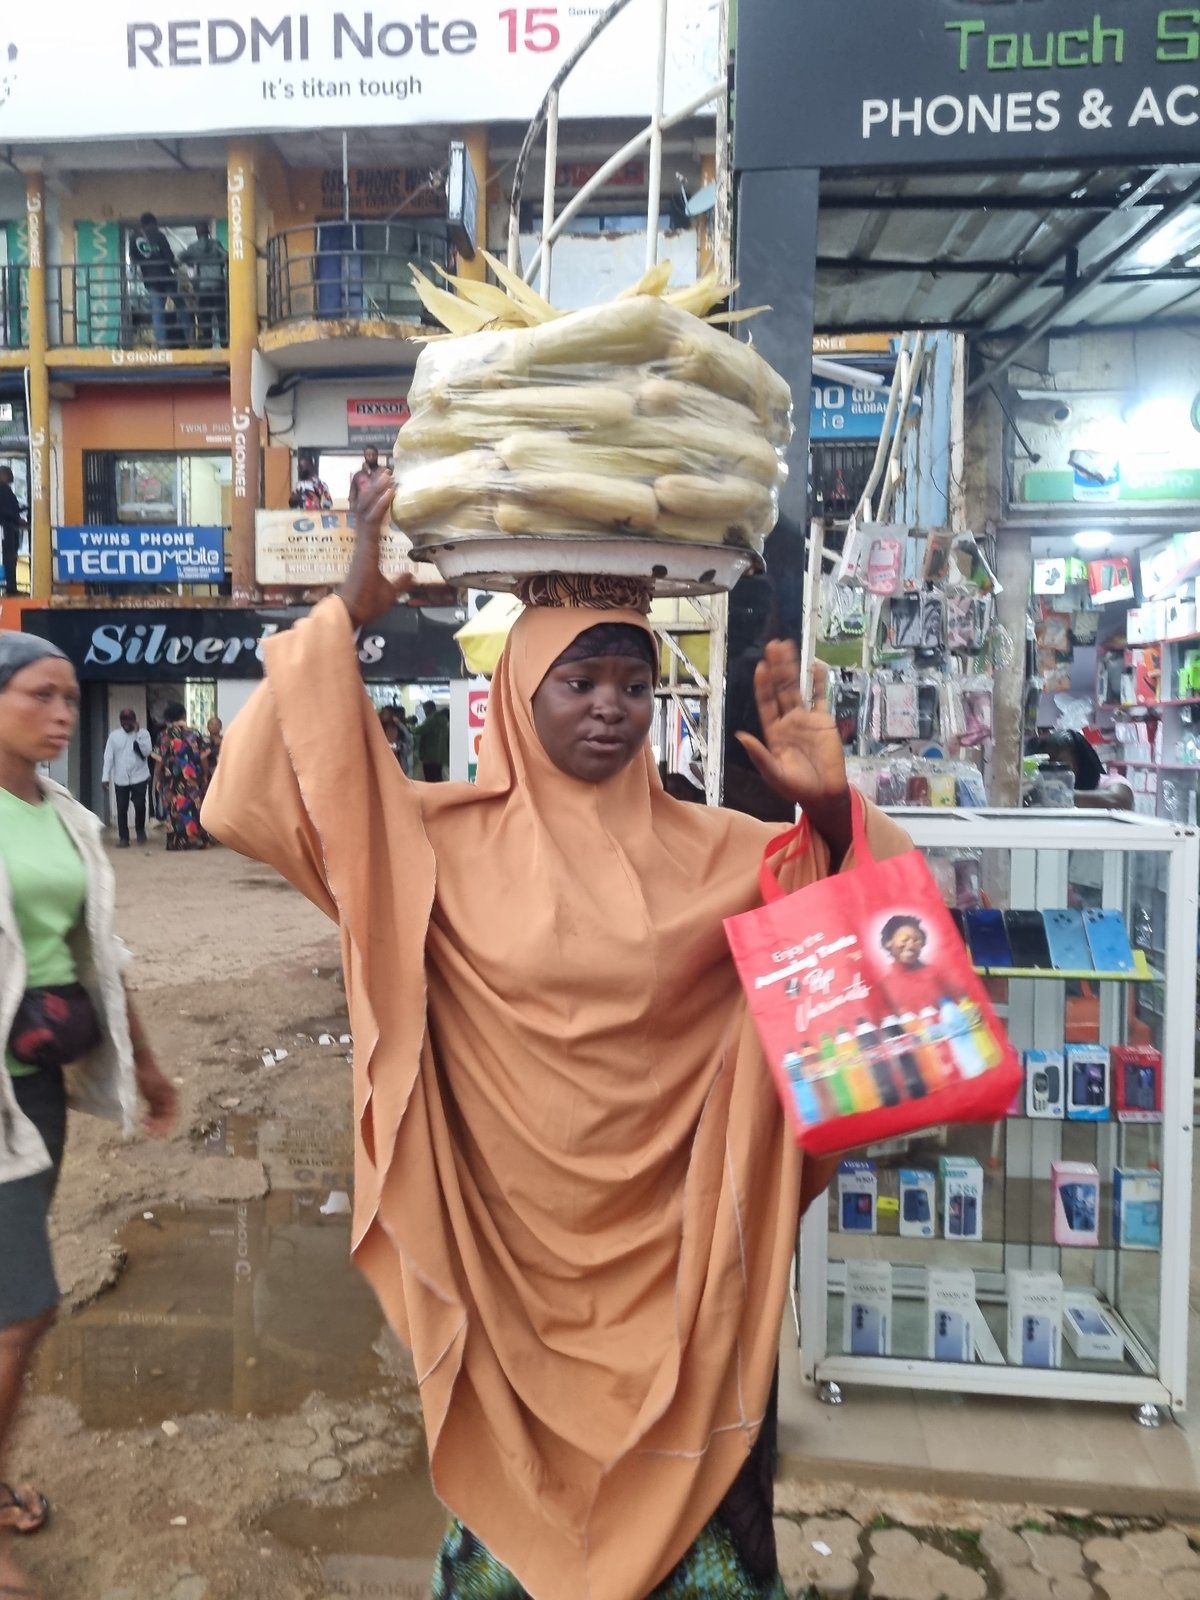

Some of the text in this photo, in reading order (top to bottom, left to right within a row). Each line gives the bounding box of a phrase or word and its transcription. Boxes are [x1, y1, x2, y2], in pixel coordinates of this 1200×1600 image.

[126, 14, 309, 69] REDMI
[333, 11, 477, 59] Note
[498, 7, 561, 54] 15
[944, 14, 1124, 71] Touch
[262, 75, 422, 100] It's titan tough
[862, 84, 1200, 138] PHONES & AC
[28, 212, 41, 269] GIONEE
[231, 194, 244, 261] GIONEE
[126, 350, 174, 362] GIONEE
[235, 433, 246, 497] GIONEE
[60, 546, 220, 575] TECNO Mobile
[79, 532, 195, 546] TWINS PHONE
[287, 535, 333, 544] OPTICAL
